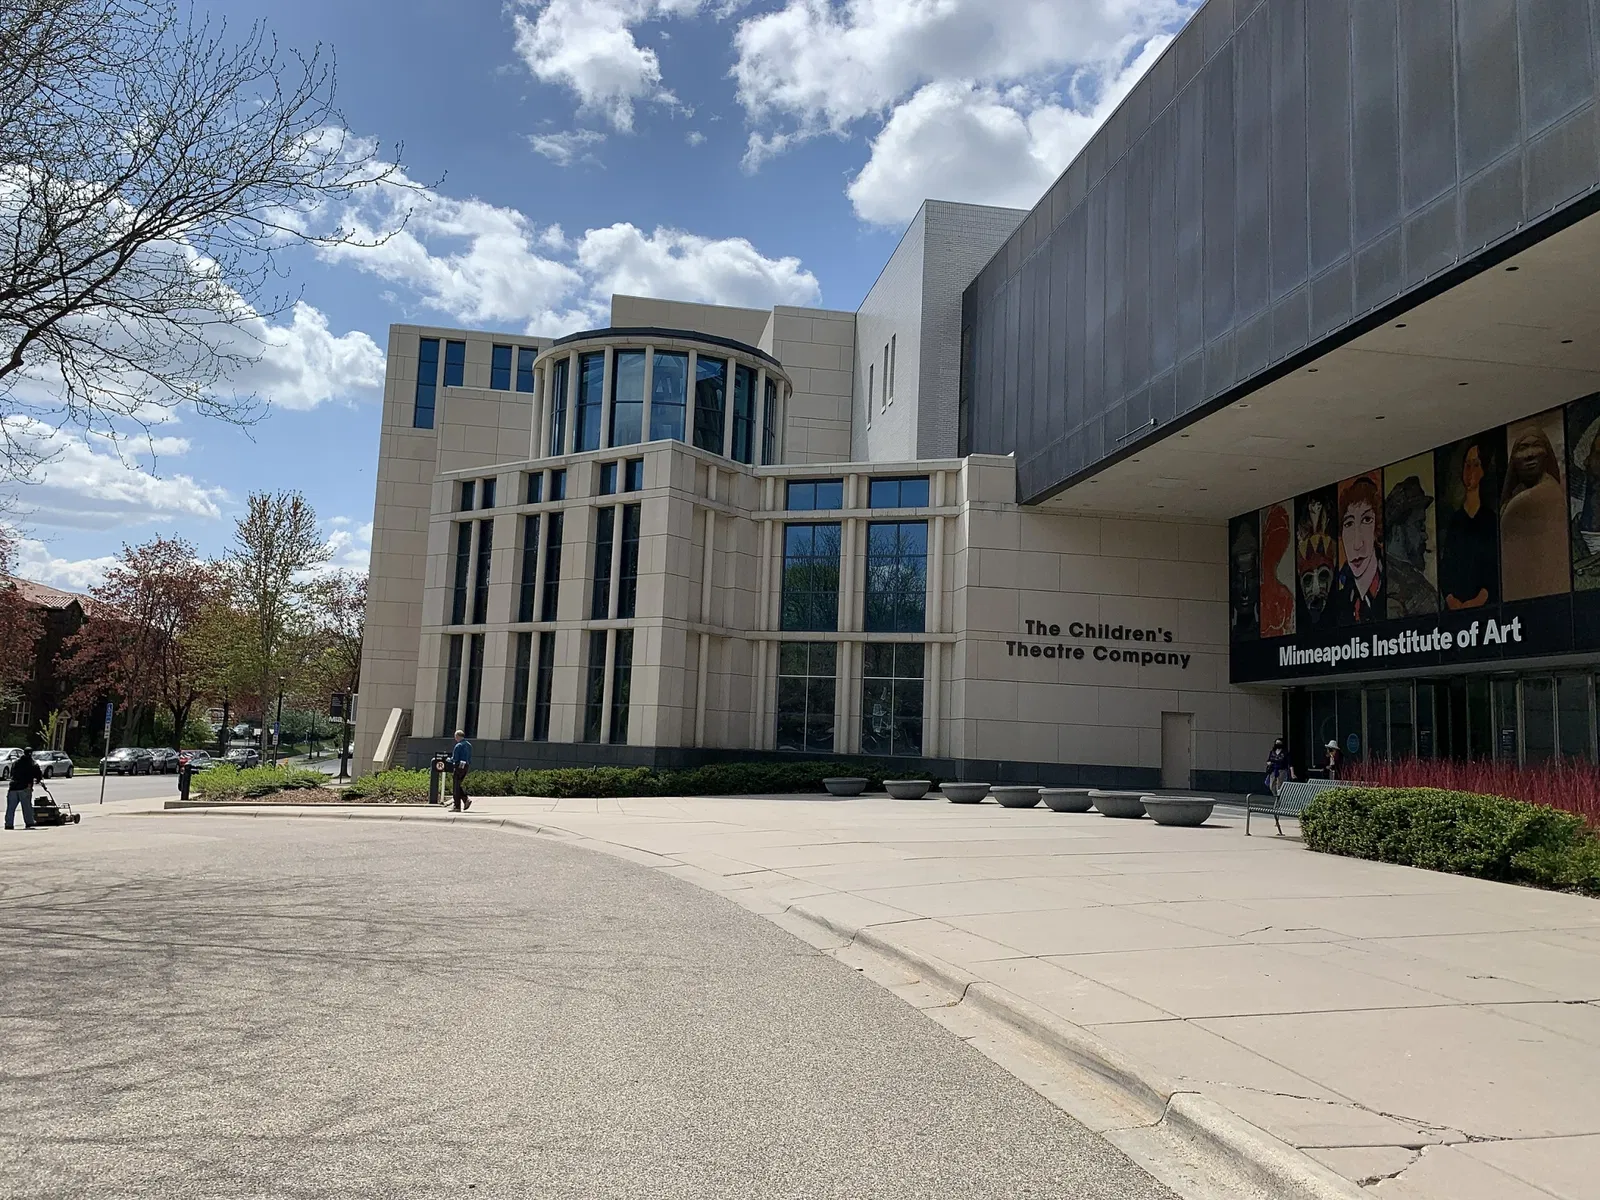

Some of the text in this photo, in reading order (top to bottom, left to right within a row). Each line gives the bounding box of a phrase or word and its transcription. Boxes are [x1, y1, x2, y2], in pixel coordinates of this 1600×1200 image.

[1025, 619, 1173, 643] The Children's
[1279, 615, 1522, 667] Minneapolis Institute of Art
[1006, 640, 1191, 670] Theatre Company
